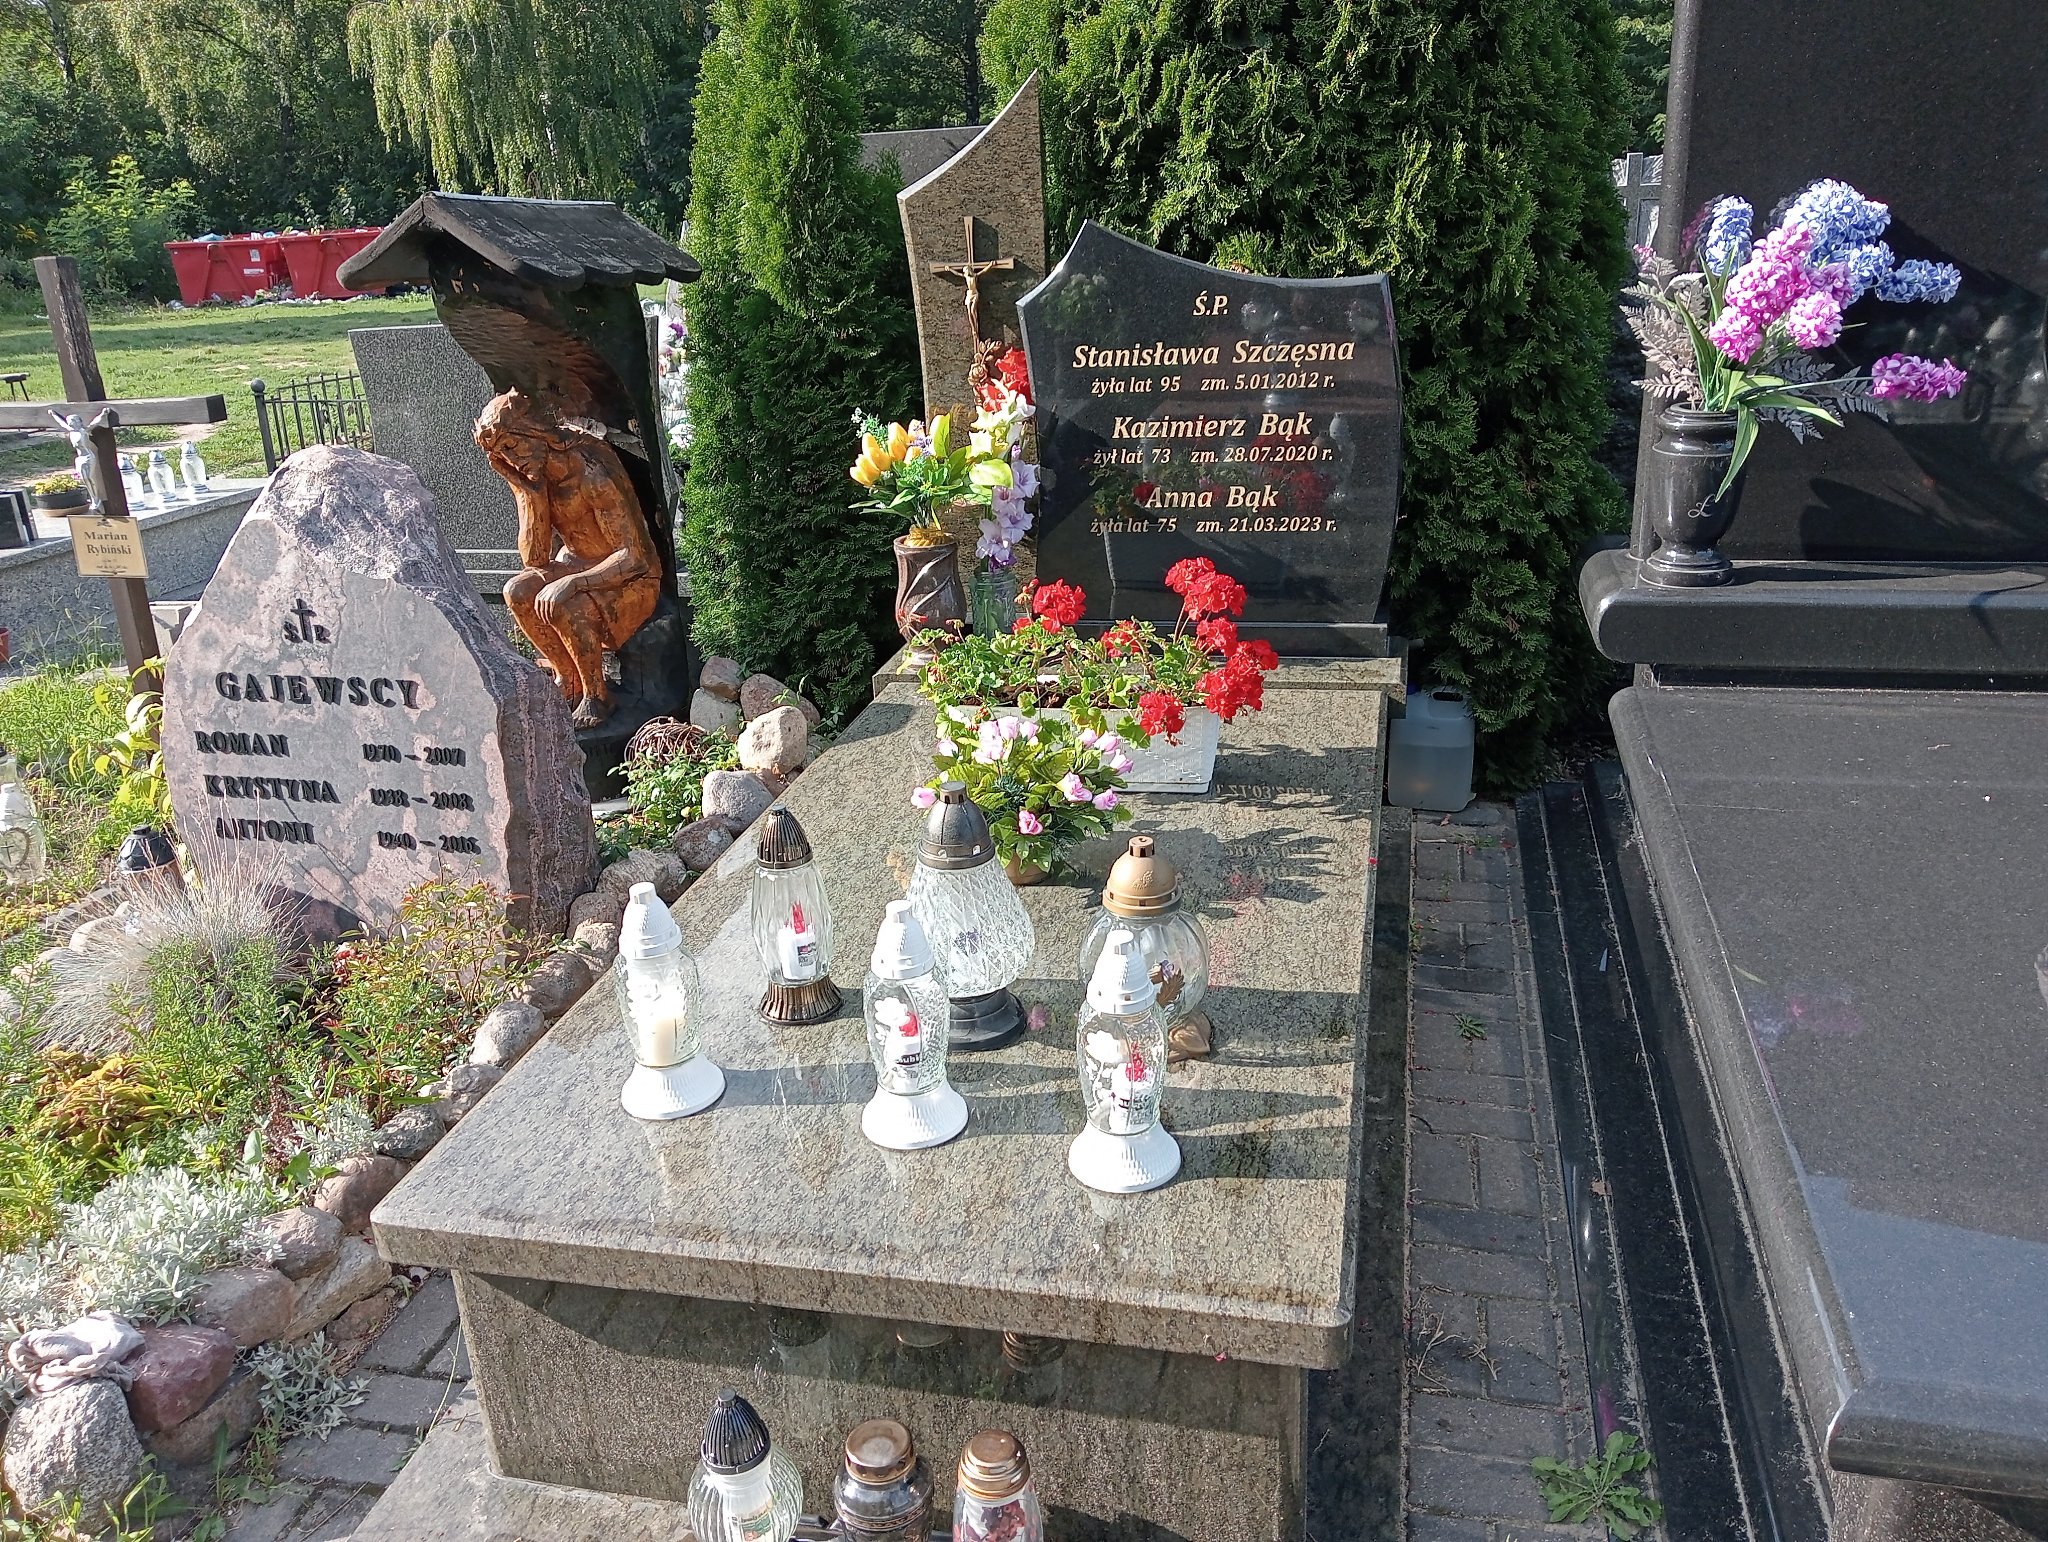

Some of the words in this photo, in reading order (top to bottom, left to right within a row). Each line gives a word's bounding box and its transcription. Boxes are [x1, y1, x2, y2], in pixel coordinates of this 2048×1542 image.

[1193, 290, 1228, 316] Ś.P.
[1072, 341, 1219, 368] Stanisława
[1232, 339, 1355, 368] Szczęsna
[1091, 377, 1125, 397] żyła
[1129, 376, 1152, 393] lat
[1160, 375, 1181, 392] 95
[1200, 377, 1230, 391] zm.
[1234, 371, 1319, 390] 5.01.2012
[1323, 374, 1335, 388] r.
[1112, 415, 1246, 439] Kazimierz
[1258, 411, 1312, 441] Bąk
[1093, 448, 1117, 467] żył
[1120, 448, 1143, 464] lat
[1151, 448, 1171, 464] 73
[1190, 450, 1219, 463] zm.
[1223, 445, 1318, 462] 28.07.2020
[1321, 447, 1333, 460] r.
[1145, 486, 1213, 508] Anna
[1225, 484, 1279, 513] Bąk
[84, 531, 128, 540] Marian
[1090, 518, 1123, 536] żyła
[1127, 517, 1149, 533] lat
[1157, 517, 1177, 532] 75
[1195, 520, 1224, 533] zm.
[1228, 516, 1322, 532] 21.03.2023
[1325, 519, 1337, 532] r.
[86, 544, 132, 556] Rybiński
[215, 671, 419, 709] GAJEWSCY
[193, 731, 291, 758] ROMAN
[203, 774, 341, 804] KRYSTYNA
[216, 817, 317, 845] ANTONI
